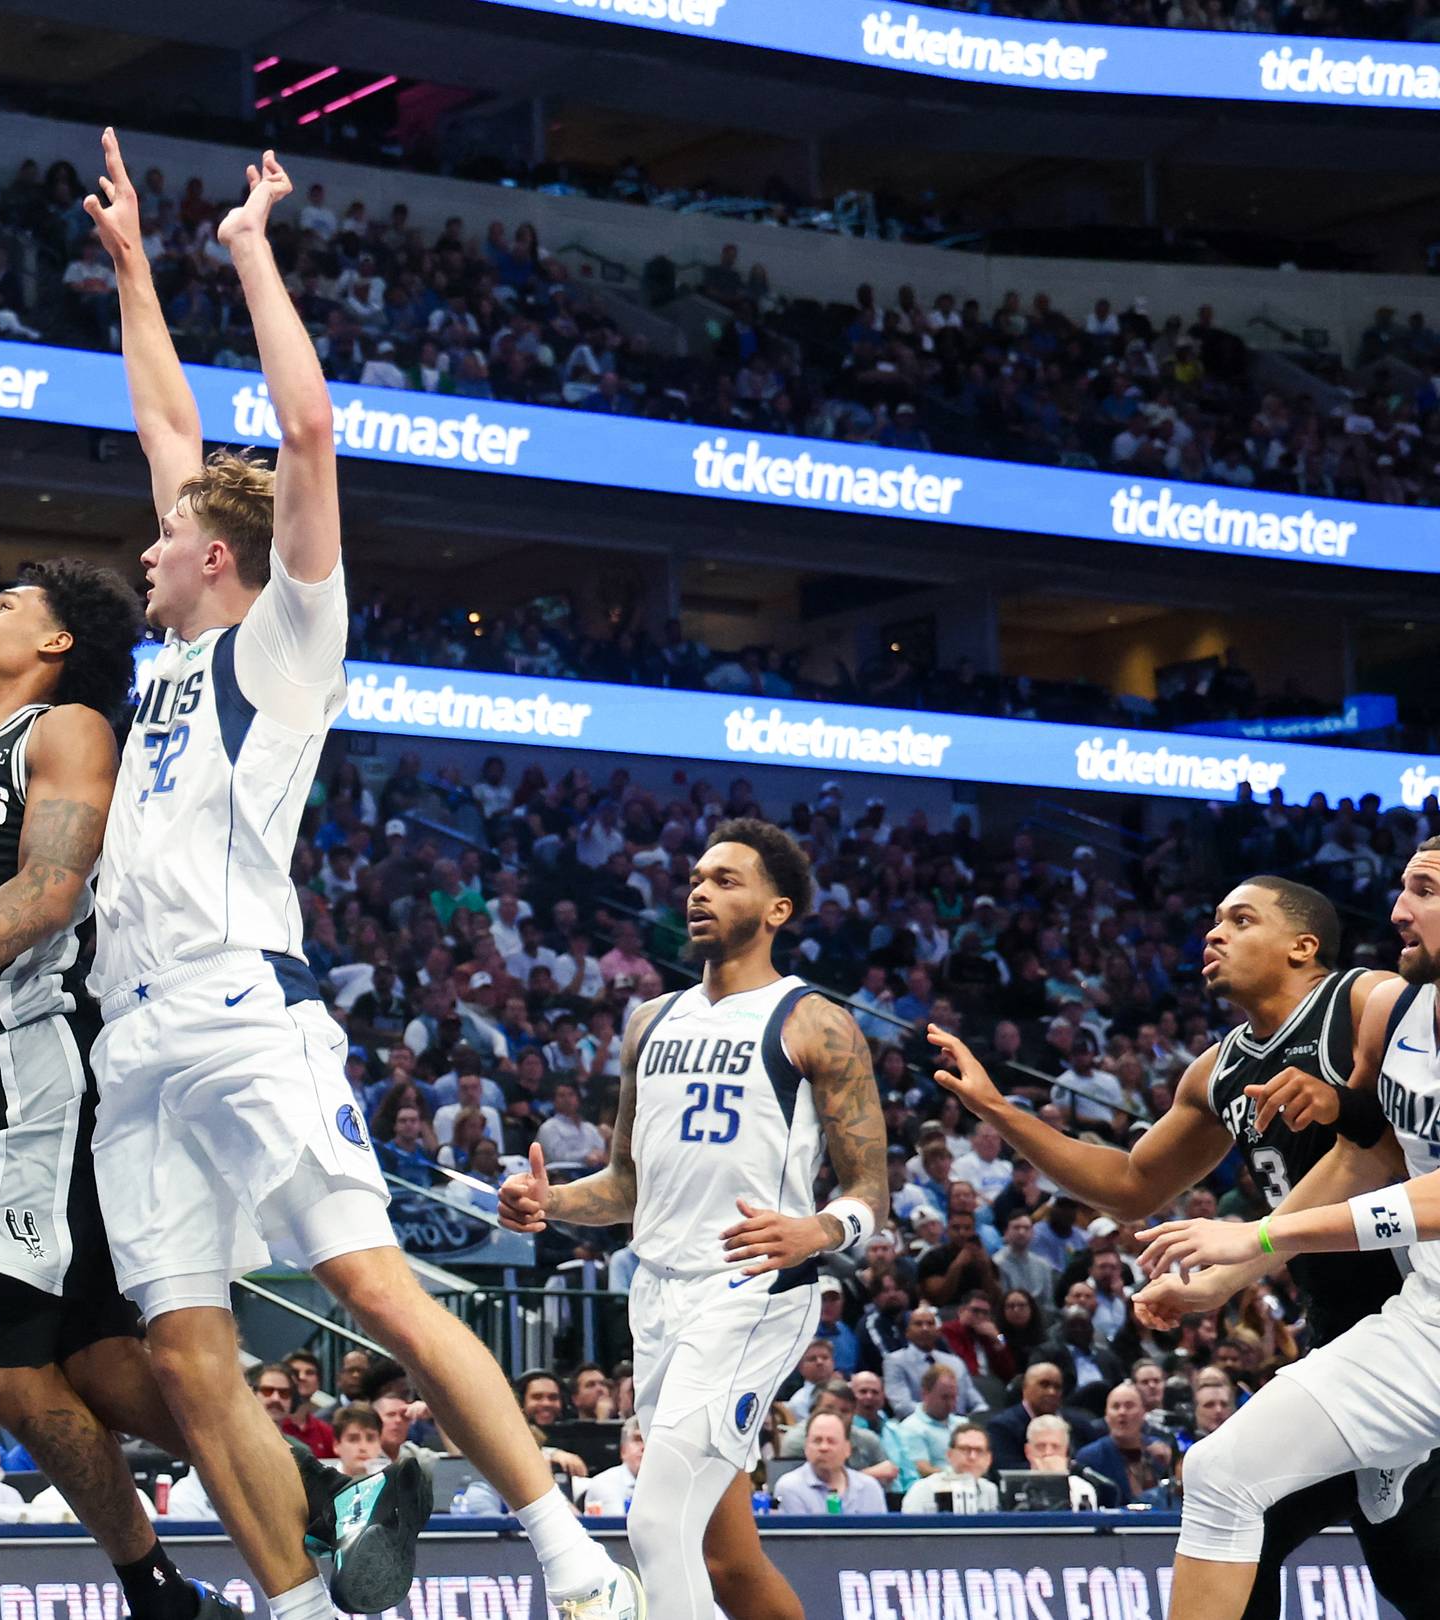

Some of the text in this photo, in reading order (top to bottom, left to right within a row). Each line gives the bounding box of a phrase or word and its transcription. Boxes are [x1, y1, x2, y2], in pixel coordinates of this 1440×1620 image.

[861, 10, 1440, 99] ticketmaster ticketma
[692, 437, 963, 514] ticketmaster
[1110, 485, 1357, 556] ticketmaster
[346, 673, 591, 738] ticketmaster
[724, 706, 952, 767] ticketmaster
[1074, 737, 1287, 794] ticketmaster
[644, 1038, 757, 1080] DALLAS
[679, 1081, 745, 1144] 25
[1250, 1146, 1292, 1211] 3
[1370, 1206, 1393, 1239] 31
[1388, 1209, 1402, 1234] KT
[838, 1567, 1056, 1620] REWARDS
[1062, 1566, 1152, 1620] FOR
